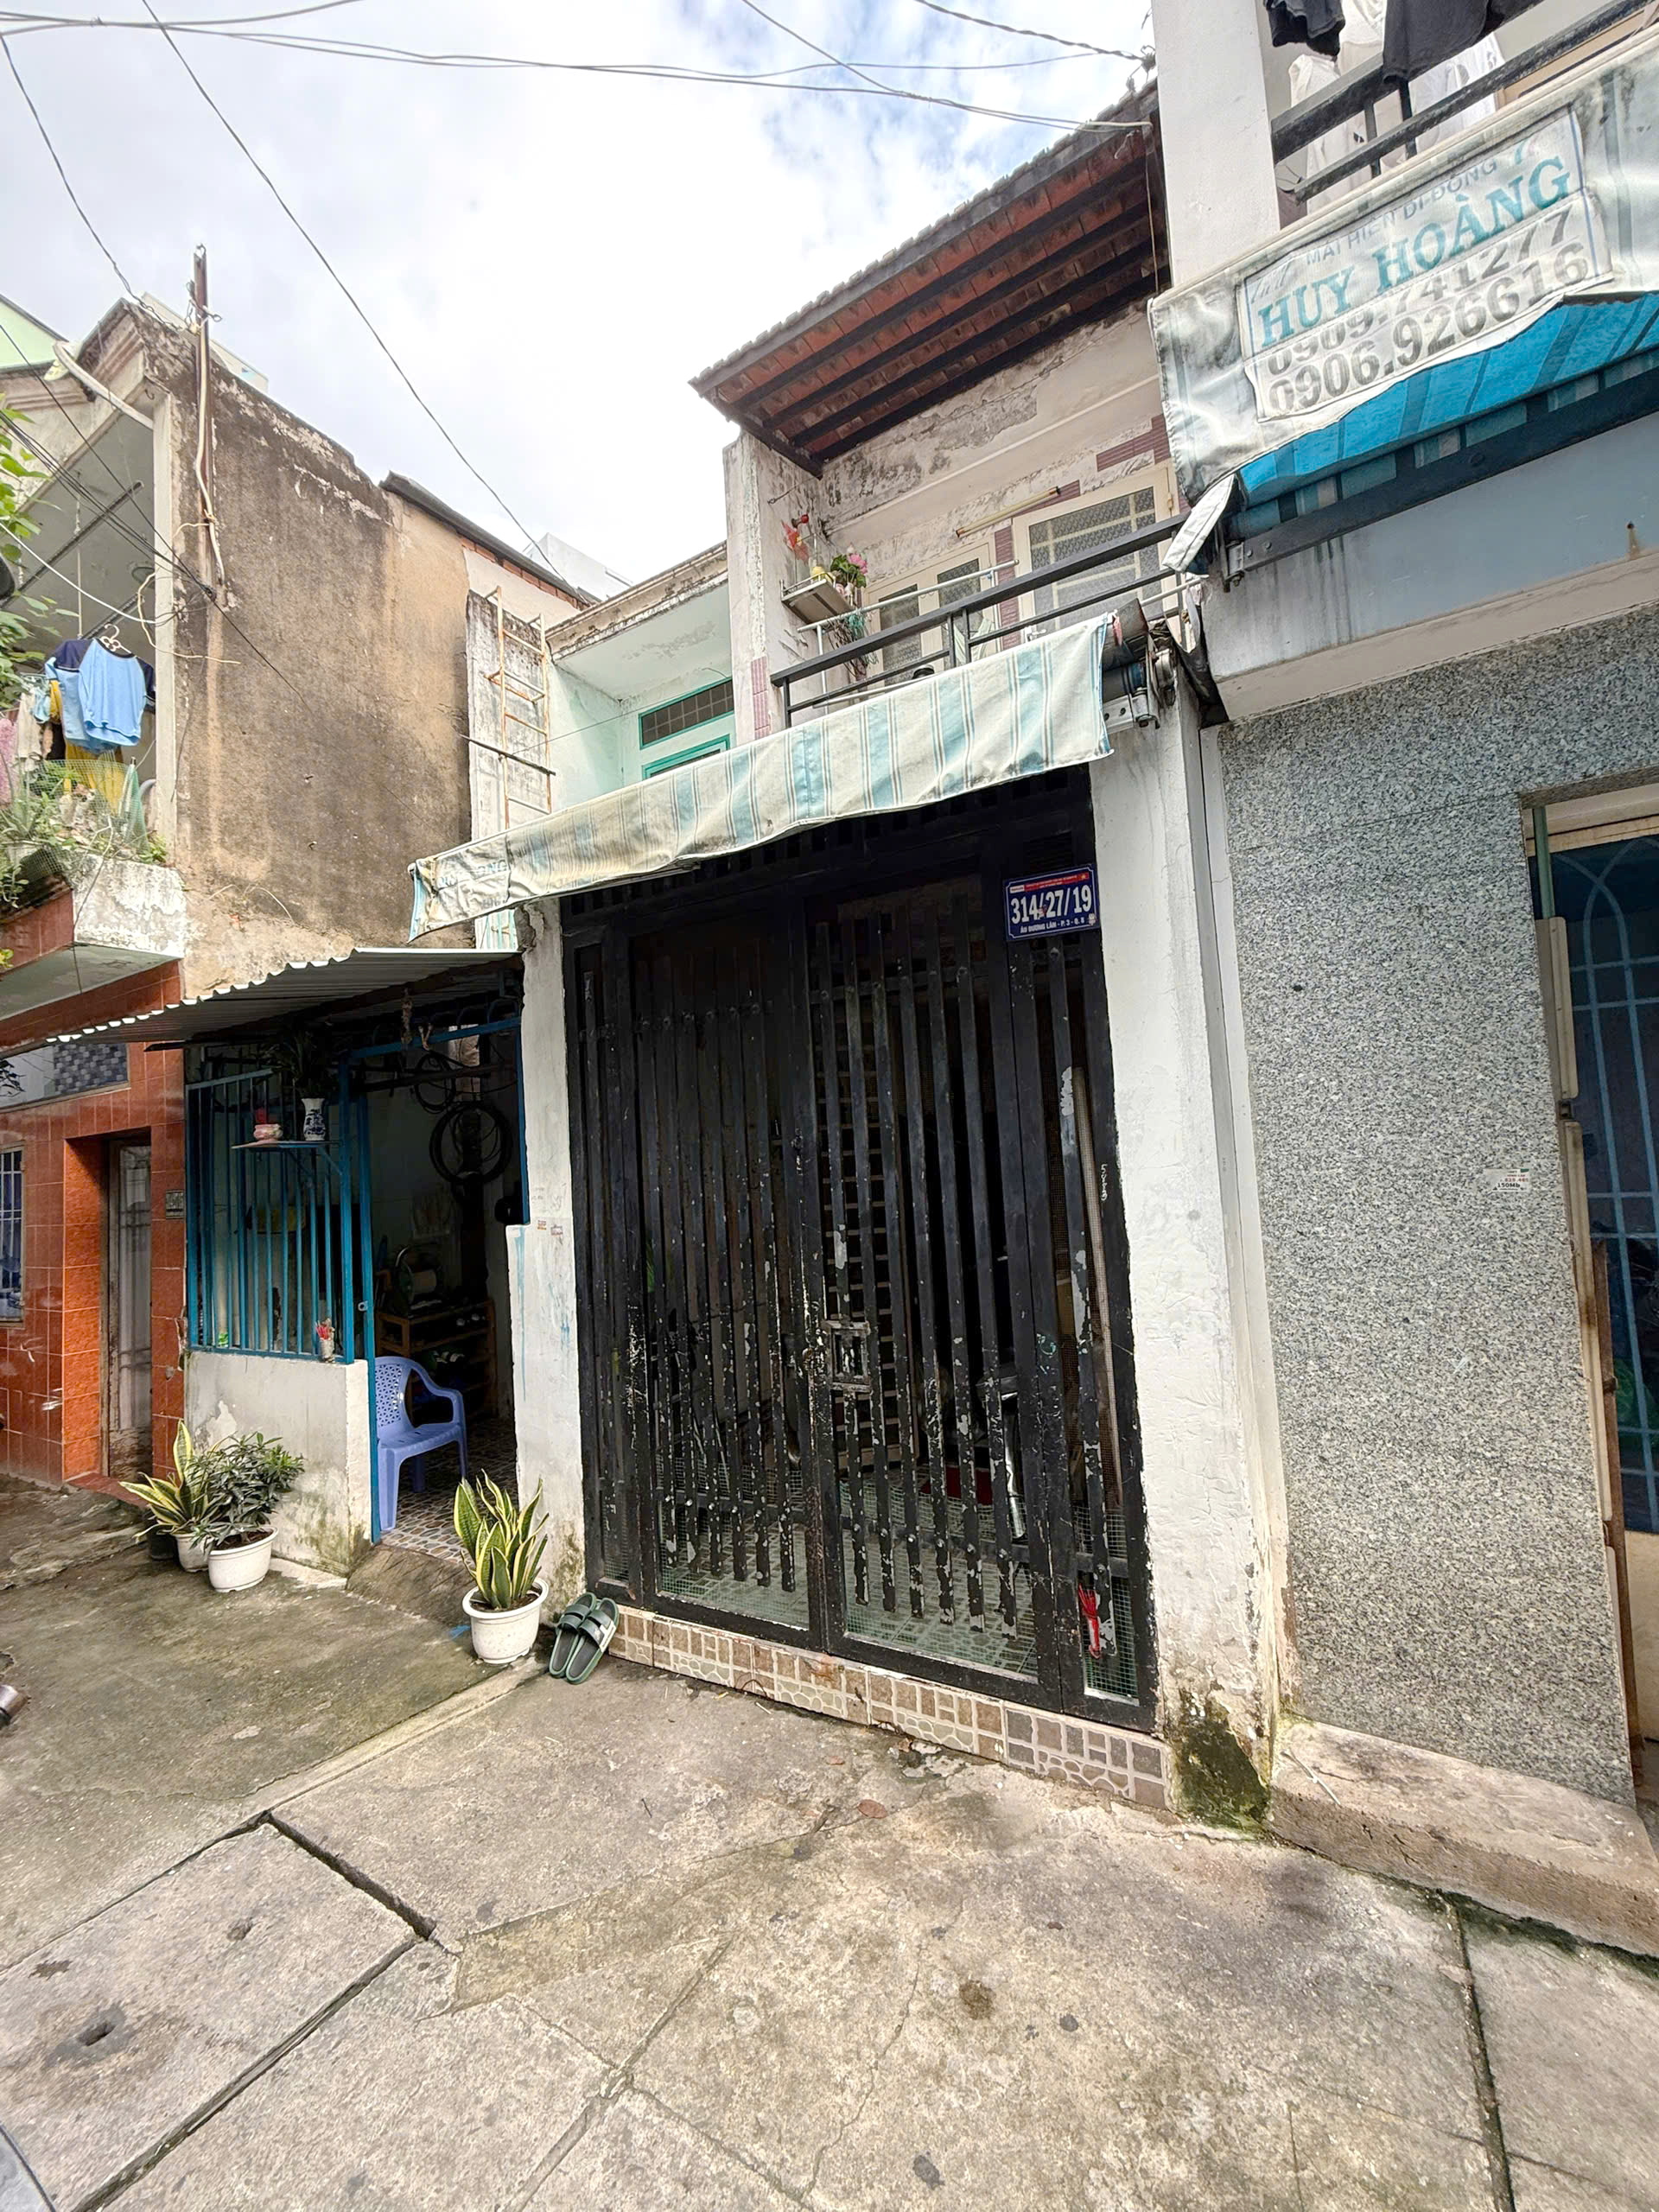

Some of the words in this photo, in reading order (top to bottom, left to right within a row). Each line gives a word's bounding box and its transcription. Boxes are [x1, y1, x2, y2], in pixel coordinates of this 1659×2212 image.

[1258, 265, 1355, 347] HUY
[1372, 156, 1571, 294] HOÀNG
[1268, 242, 1589, 411] 0906.926616
[1011, 885, 1092, 924] 314/27/19
